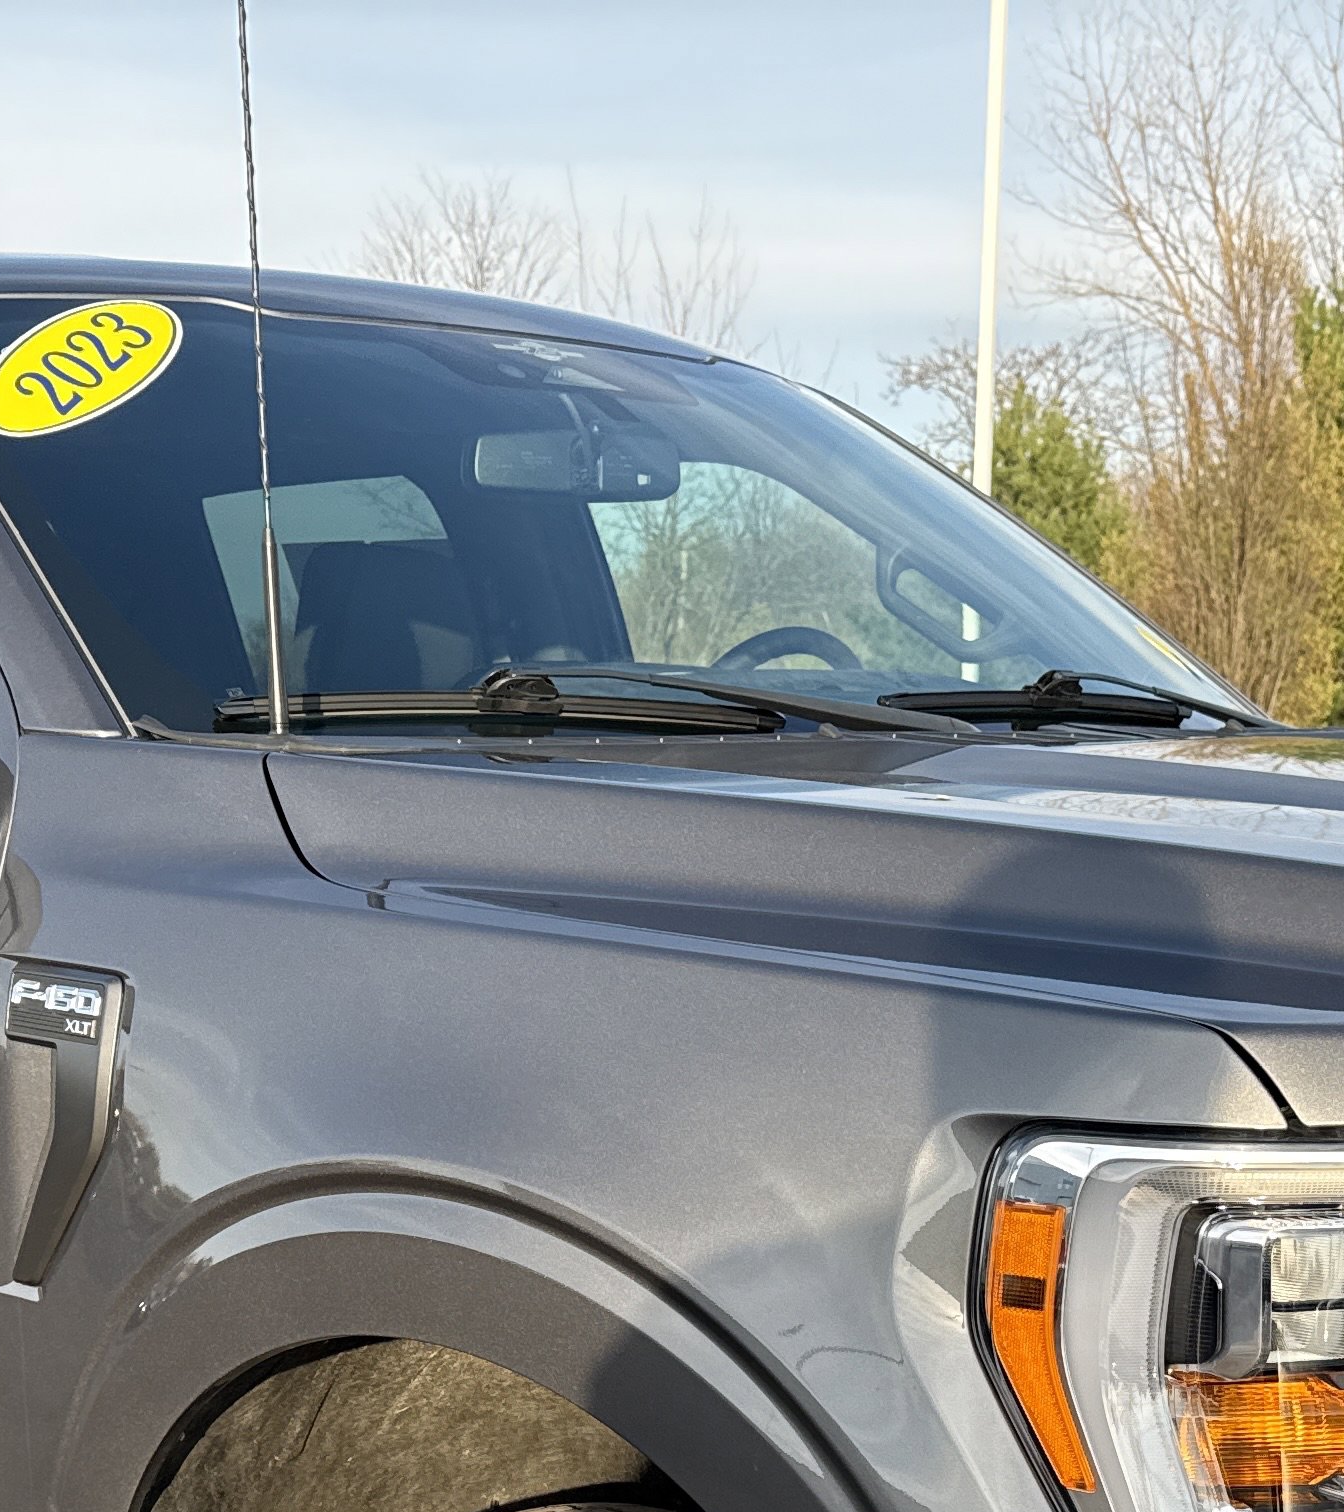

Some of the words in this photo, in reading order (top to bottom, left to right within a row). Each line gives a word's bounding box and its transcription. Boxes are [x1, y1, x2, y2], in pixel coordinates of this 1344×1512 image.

[14, 311, 153, 416] 2023
[11, 979, 101, 1016] F-150
[64, 1018, 92, 1036] XLT
